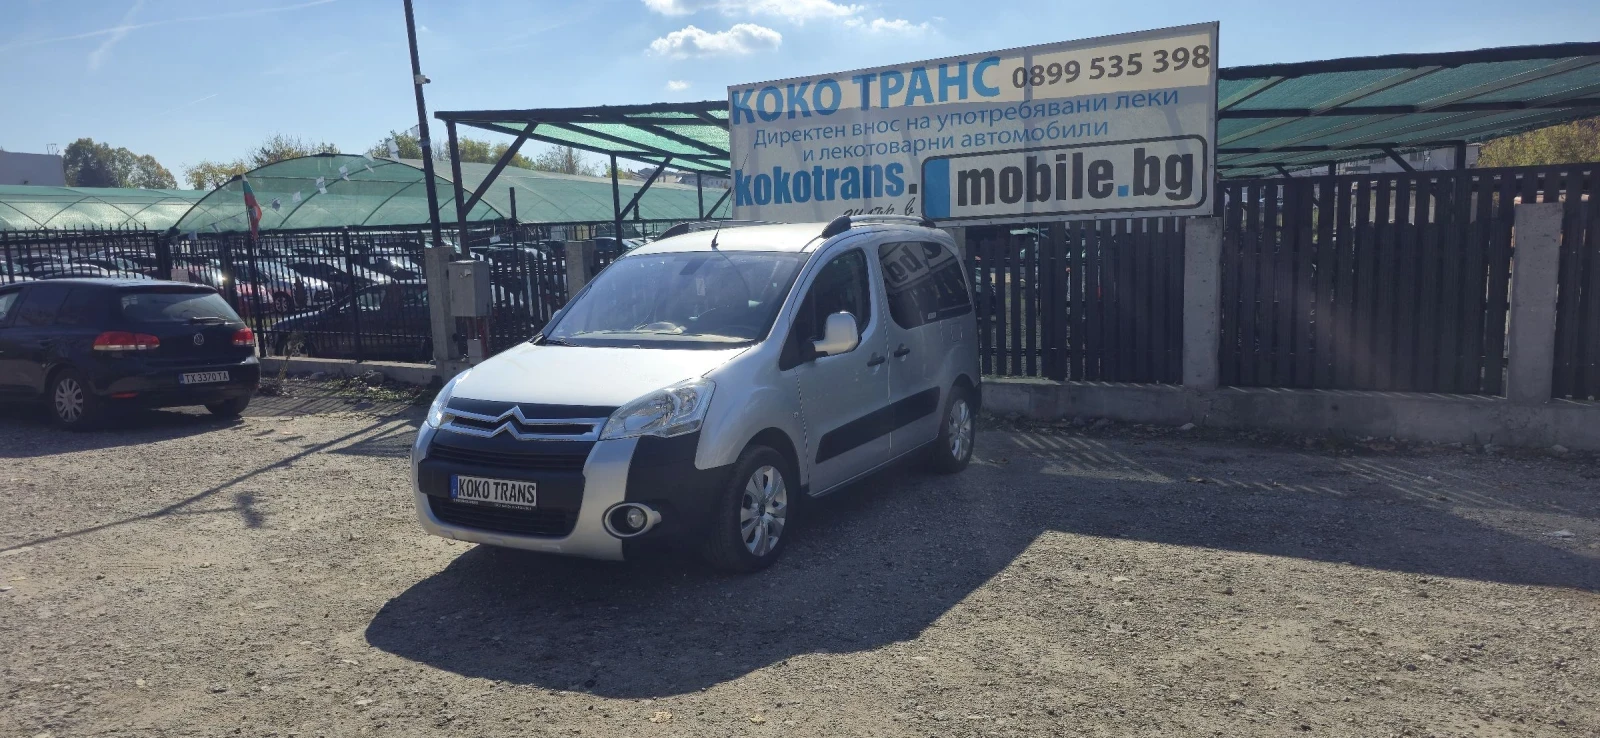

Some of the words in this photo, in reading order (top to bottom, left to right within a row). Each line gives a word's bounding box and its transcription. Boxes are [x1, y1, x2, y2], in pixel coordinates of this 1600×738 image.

[1012, 60, 1081, 89] 0899
[1089, 52, 1143, 80] 535
[1152, 44, 1210, 73] 398
[732, 78, 842, 125] КОКО
[852, 56, 1001, 111] ТРАНС
[753, 123, 846, 148] Директен
[852, 118, 900, 137] внос
[907, 115, 930, 130] на
[936, 96, 1108, 132] употребявани
[1115, 89, 1179, 110] леки
[803, 149, 814, 161] и
[819, 135, 954, 161] лекотоварни
[960, 120, 1109, 148] автомобили
[734, 162, 918, 207] kokotrans.
[957, 147, 1194, 206] mobile.bg
[185, 374, 197, 383] TX
[198, 372, 217, 382] 3370
[217, 372, 228, 381] TA
[459, 478, 490, 499] KOKO
[493, 482, 535, 504] TRANS
